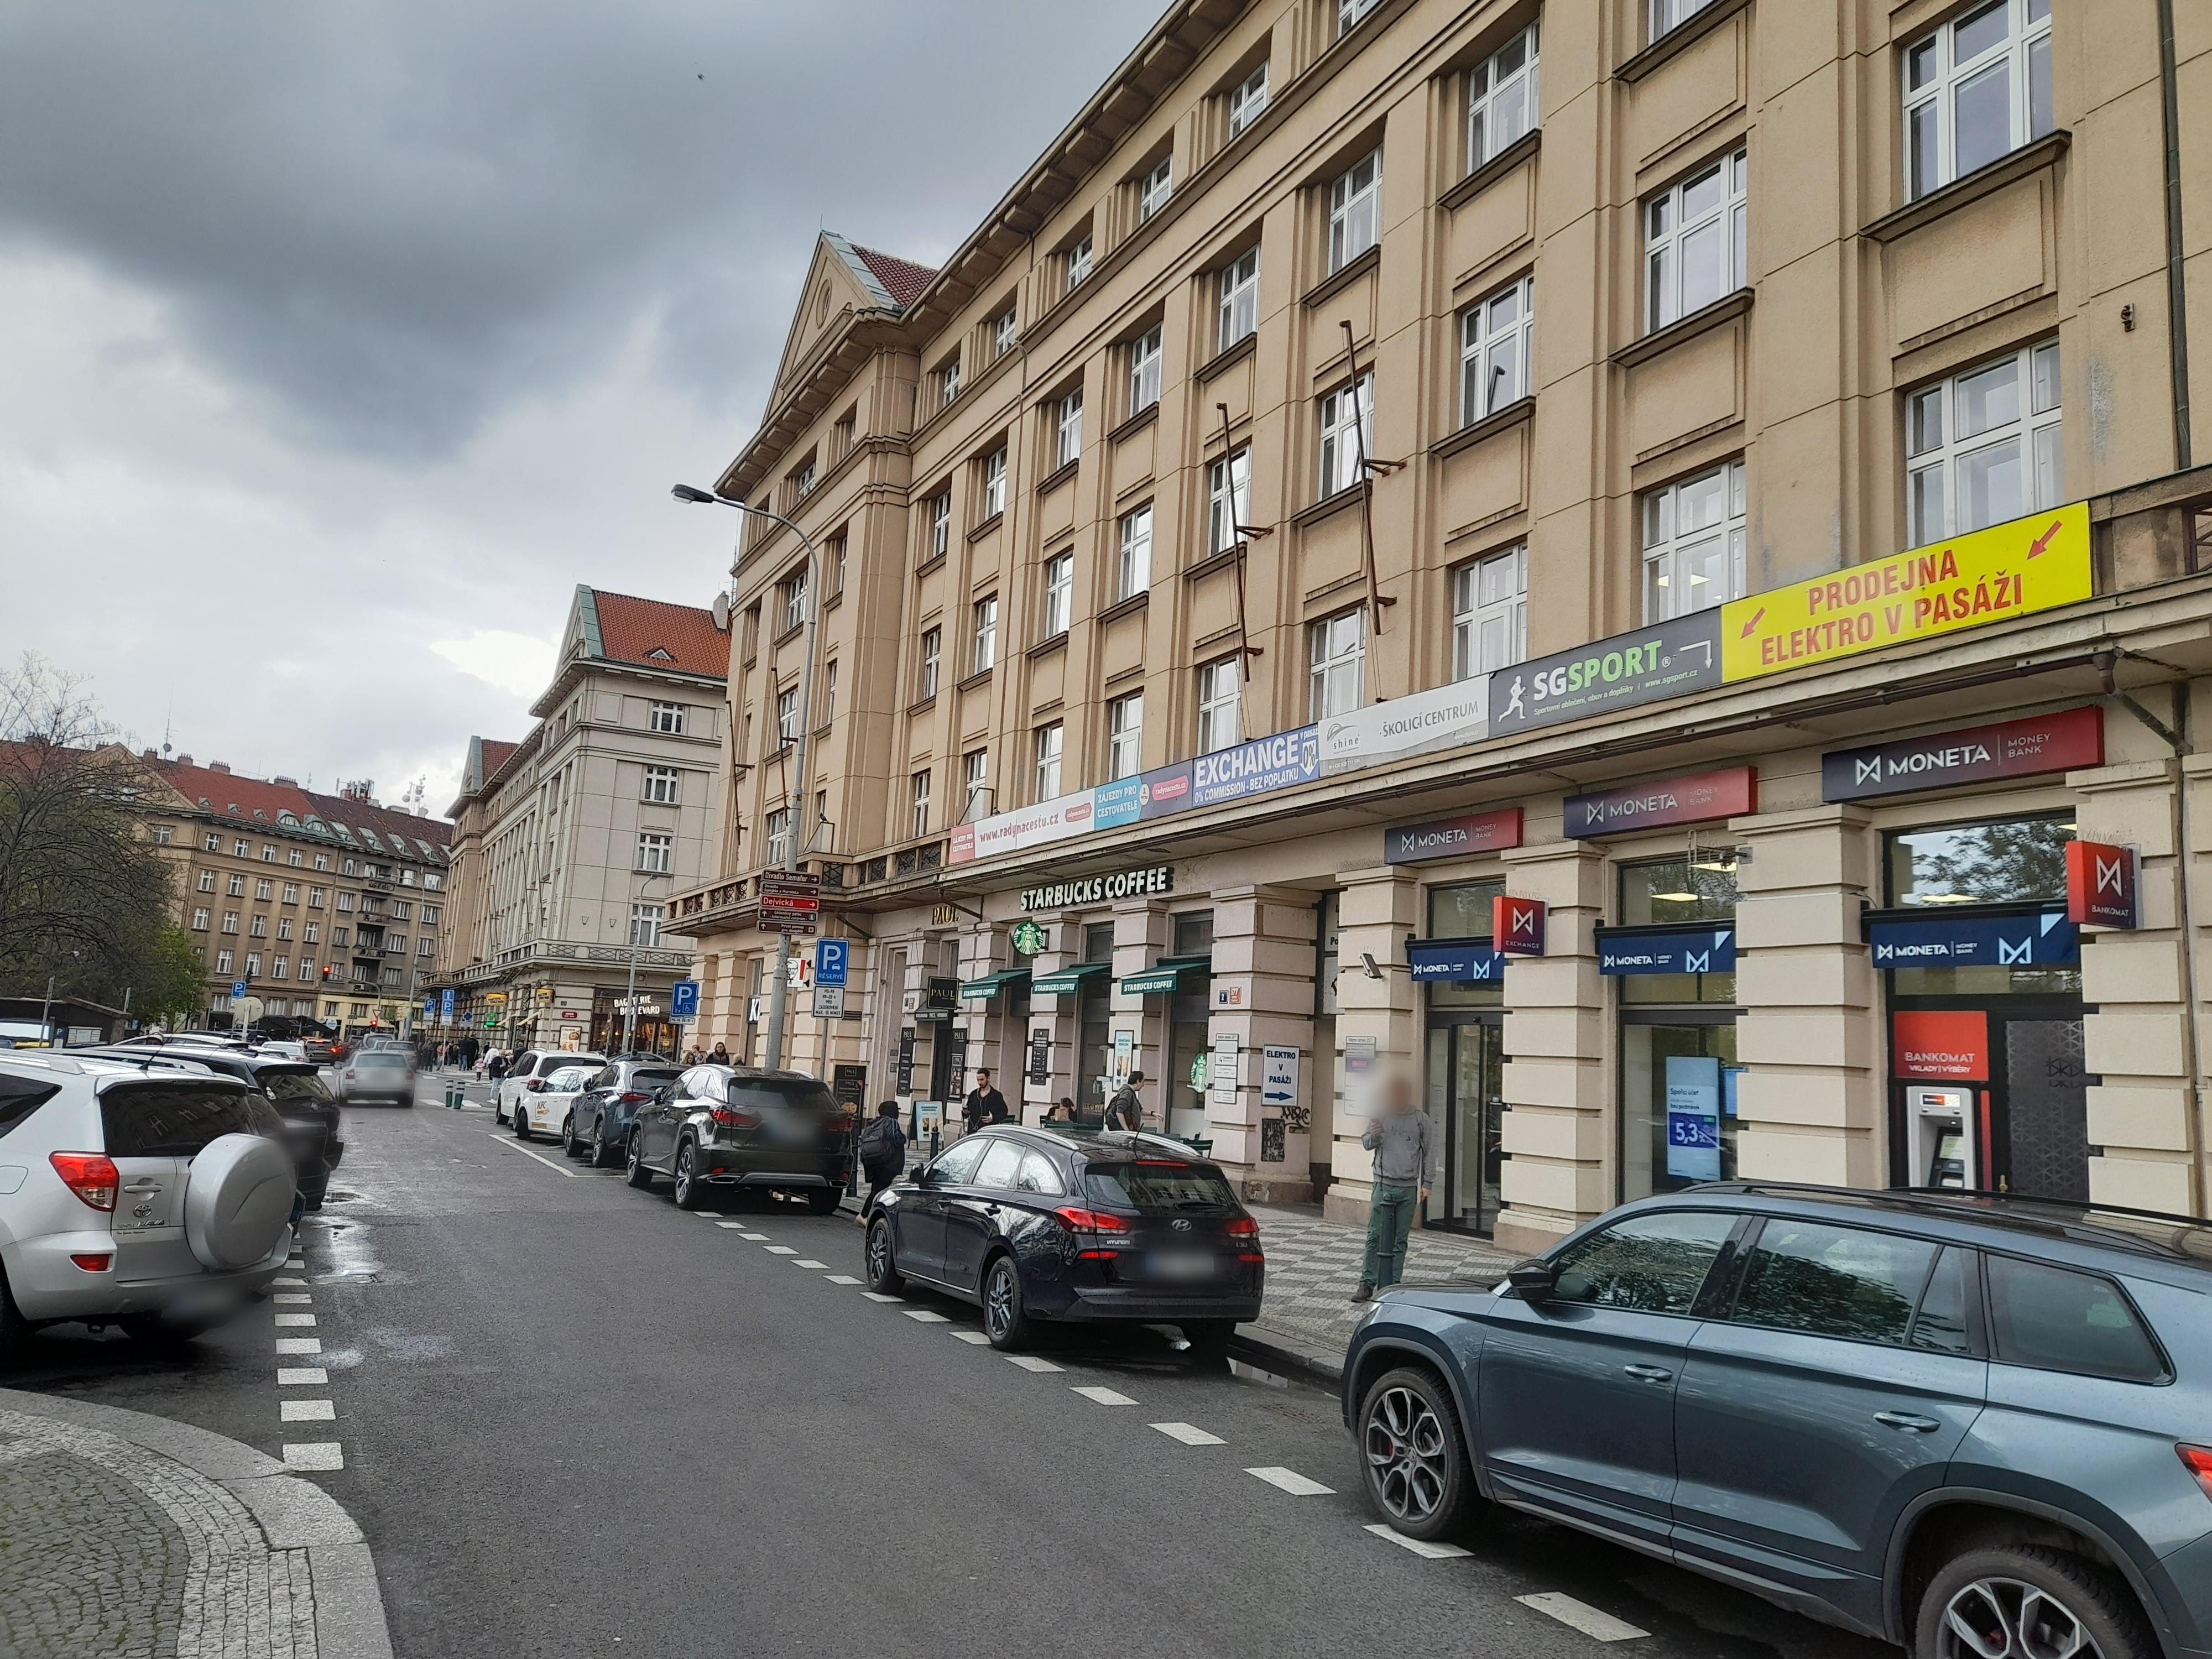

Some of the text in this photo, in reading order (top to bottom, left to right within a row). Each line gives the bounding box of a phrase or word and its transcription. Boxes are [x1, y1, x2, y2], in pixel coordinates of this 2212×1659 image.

[1808, 550, 1958, 615] PRODEJNA
[1761, 568, 2023, 665] ELEKTRO V PASÁŽI
[1533, 639, 1662, 701] SGSPORT
[1645, 670, 1698, 688] www.sgsport.cz
[1534, 703, 1561, 716] Sportovní
[1561, 696, 1587, 709] oblečení,
[1588, 693, 1603, 703] obuv
[1609, 684, 1634, 697] doplňky
[1383, 701, 1478, 737] ŠKOLICÍ CENTRUM
[1333, 737, 1359, 749] shine
[2007, 733, 2052, 748] MONEY
[1195, 734, 1298, 787] EXCHANGE
[1303, 743, 1316, 769] 0%
[1888, 744, 1991, 776] MONETA
[2007, 745, 2042, 759] BANK
[1194, 767, 1298, 803] 0% COMMISSION BEZ POPLATKU
[1690, 786, 1717, 796] MONEY
[1098, 785, 1137, 804] ZÁJEZDY PRO
[1690, 796, 1712, 805] BANK
[1097, 800, 1138, 818] CESTOVATELE
[1610, 794, 1678, 817] MONETA
[980, 813, 1058, 842] www.radynacestu.cz
[1418, 829, 1468, 847] MONETA
[1020, 867, 1167, 911] STARBUCKS COFFEE
[763, 897, 794, 906] Dejvická
[932, 906, 960, 925] PAUL
[2091, 905, 2130, 917] BANKOMAT
[1505, 940, 1540, 949] EXCHANGE
[1895, 944, 1949, 956] MONETA
[823, 945, 841, 970] P
[1616, 956, 1653, 965] MONETA
[1423, 964, 1449, 973] MONETA
[931, 989, 956, 998] PAUL
[1124, 980, 1172, 992] STARBUCKS COFFEE
[677, 987, 692, 1005] P
[1266, 1050, 1296, 1059] ELEKTRO
[1905, 1052, 1976, 1063] BANKOMAT
[1942, 1065, 1971, 1073] VÝBĚRY
[1269, 1075, 1291, 1084] PASÁŽI
[537, 1101, 547, 1109] KFC
